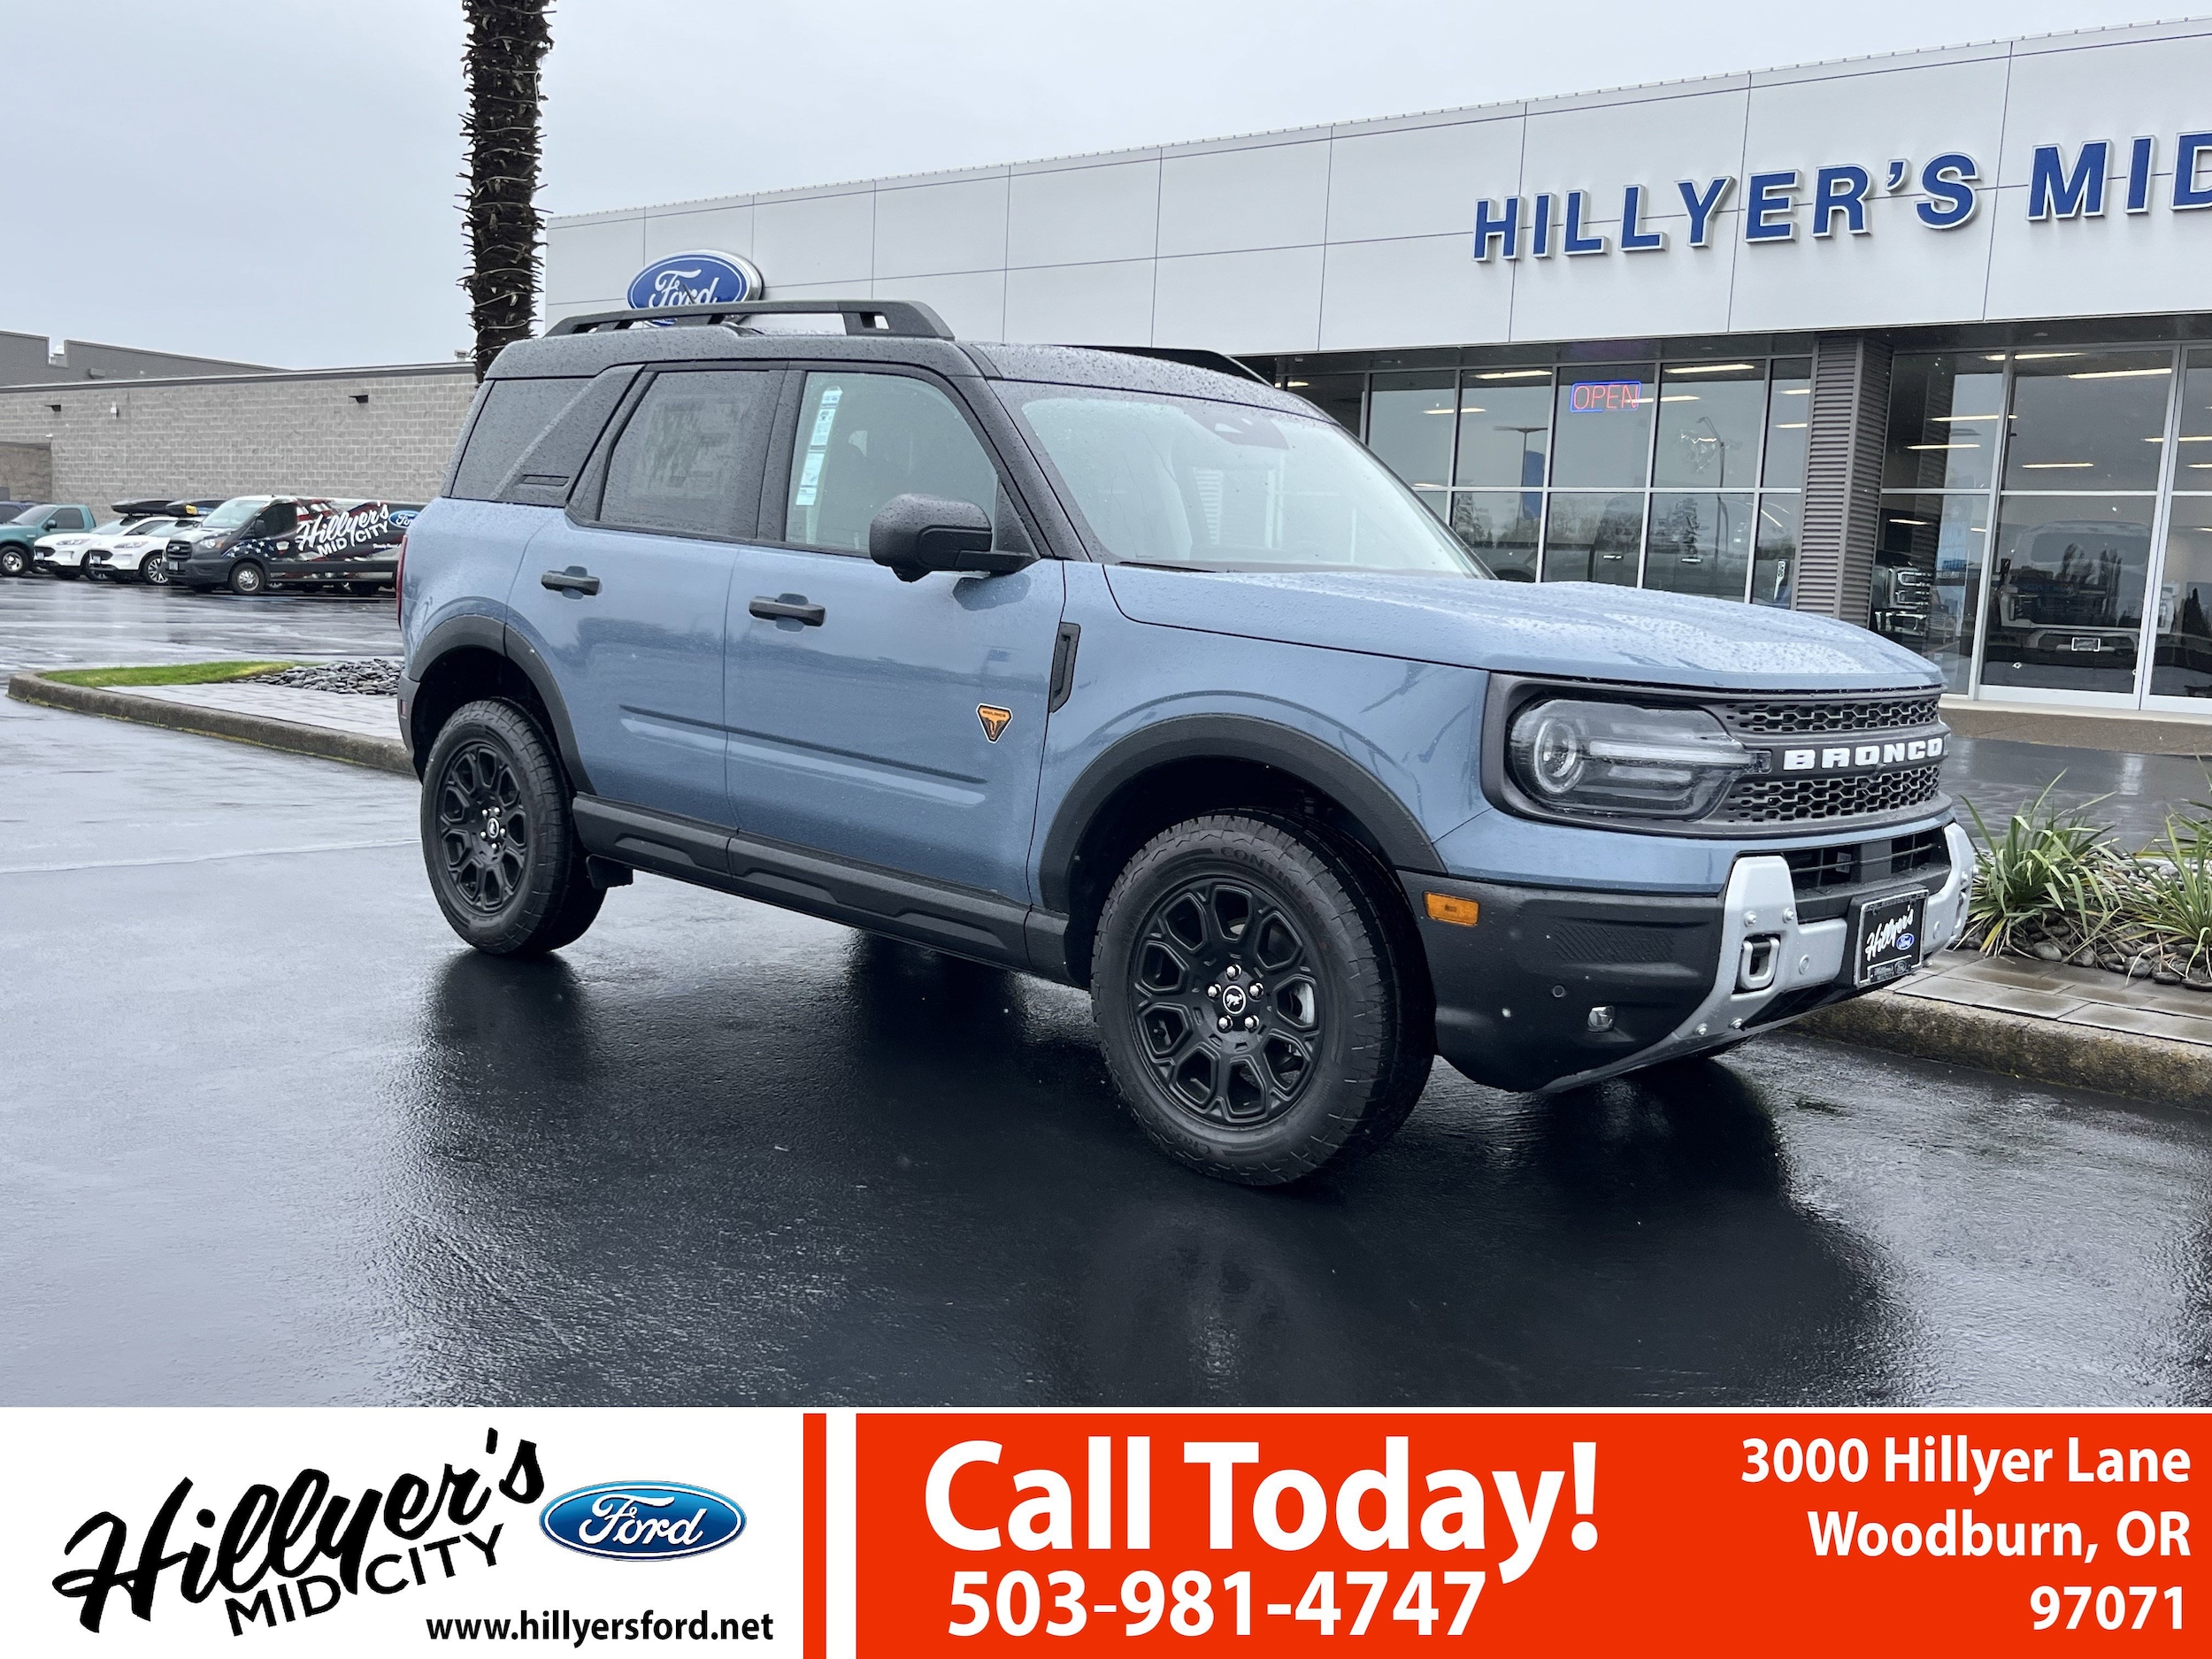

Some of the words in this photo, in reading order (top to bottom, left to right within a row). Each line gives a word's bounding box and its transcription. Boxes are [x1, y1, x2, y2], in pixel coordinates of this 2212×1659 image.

[1471, 152, 1978, 259] HILLYER'S
[2026, 133, 2212, 219] MID
[649, 269, 719, 307] Ford
[1573, 384, 1639, 410] OPEN
[295, 500, 389, 551] Hillyer's
[316, 538, 348, 557] MID
[355, 520, 388, 543] CITY
[1783, 738, 1943, 771] BRONCO
[1865, 904, 1914, 962] Hillyer's
